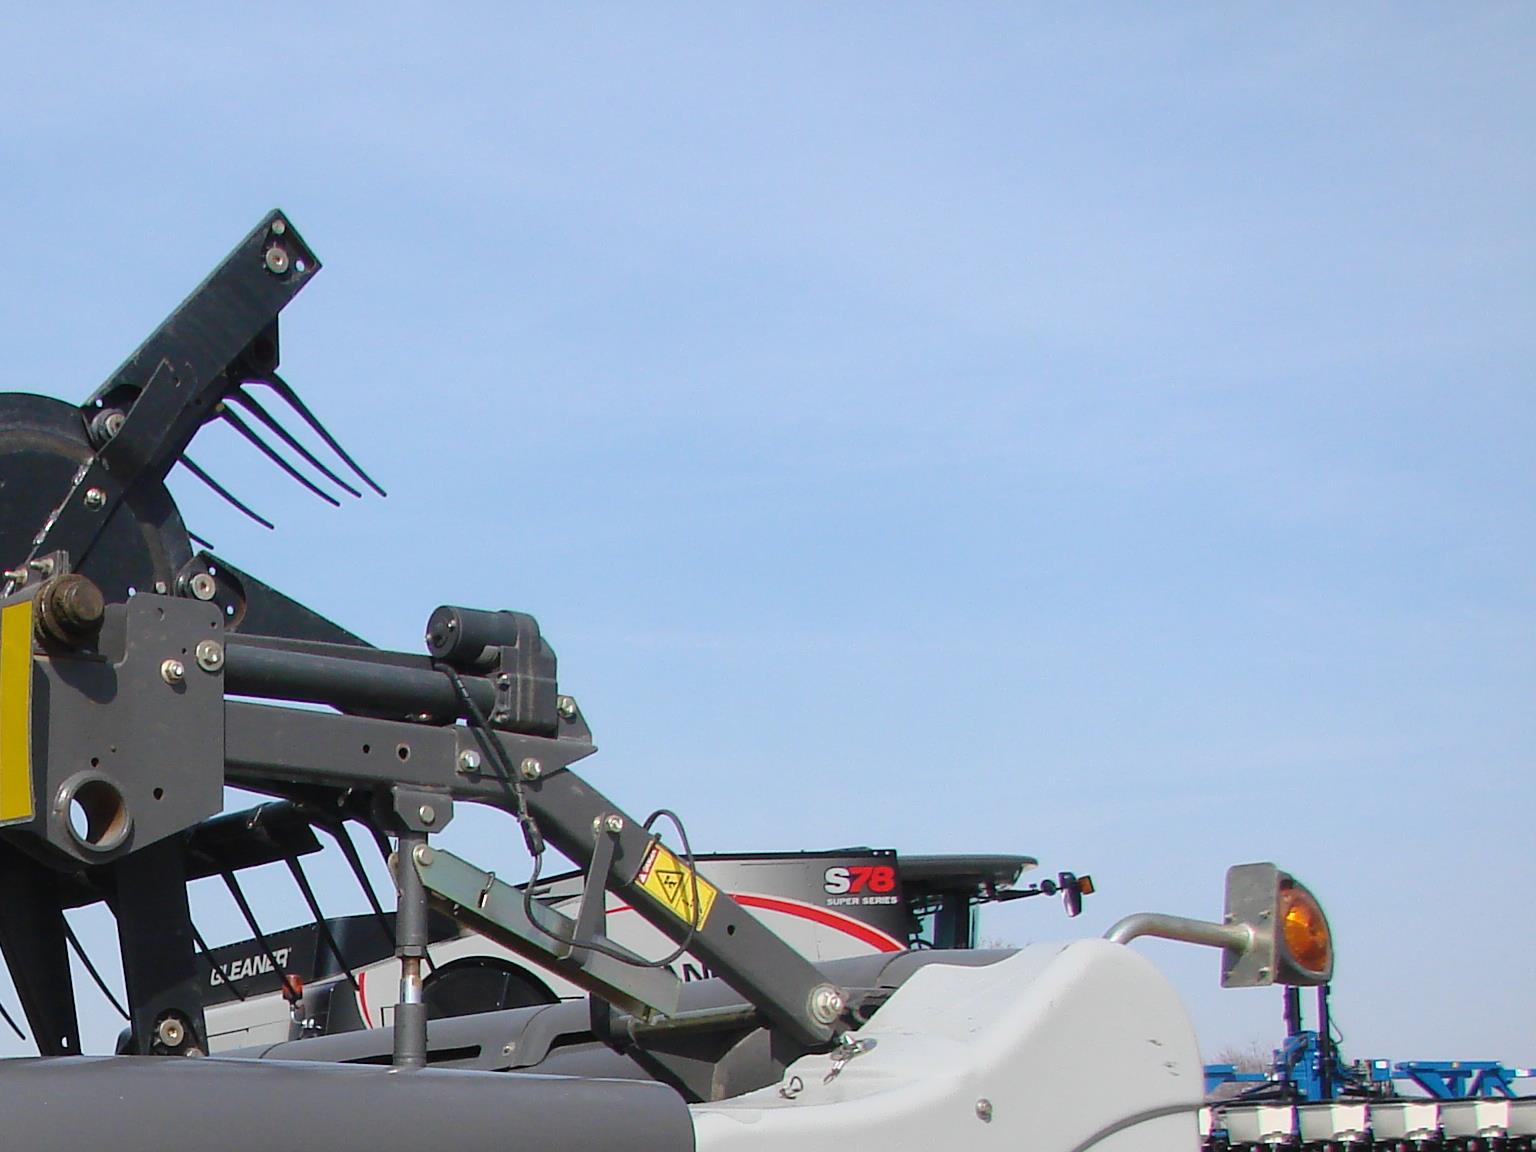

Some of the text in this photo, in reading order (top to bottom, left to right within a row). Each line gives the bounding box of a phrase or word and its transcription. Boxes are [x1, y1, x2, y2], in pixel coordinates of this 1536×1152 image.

[824, 866, 896, 895] S78
[826, 896, 898, 906] SUPER SERIES
